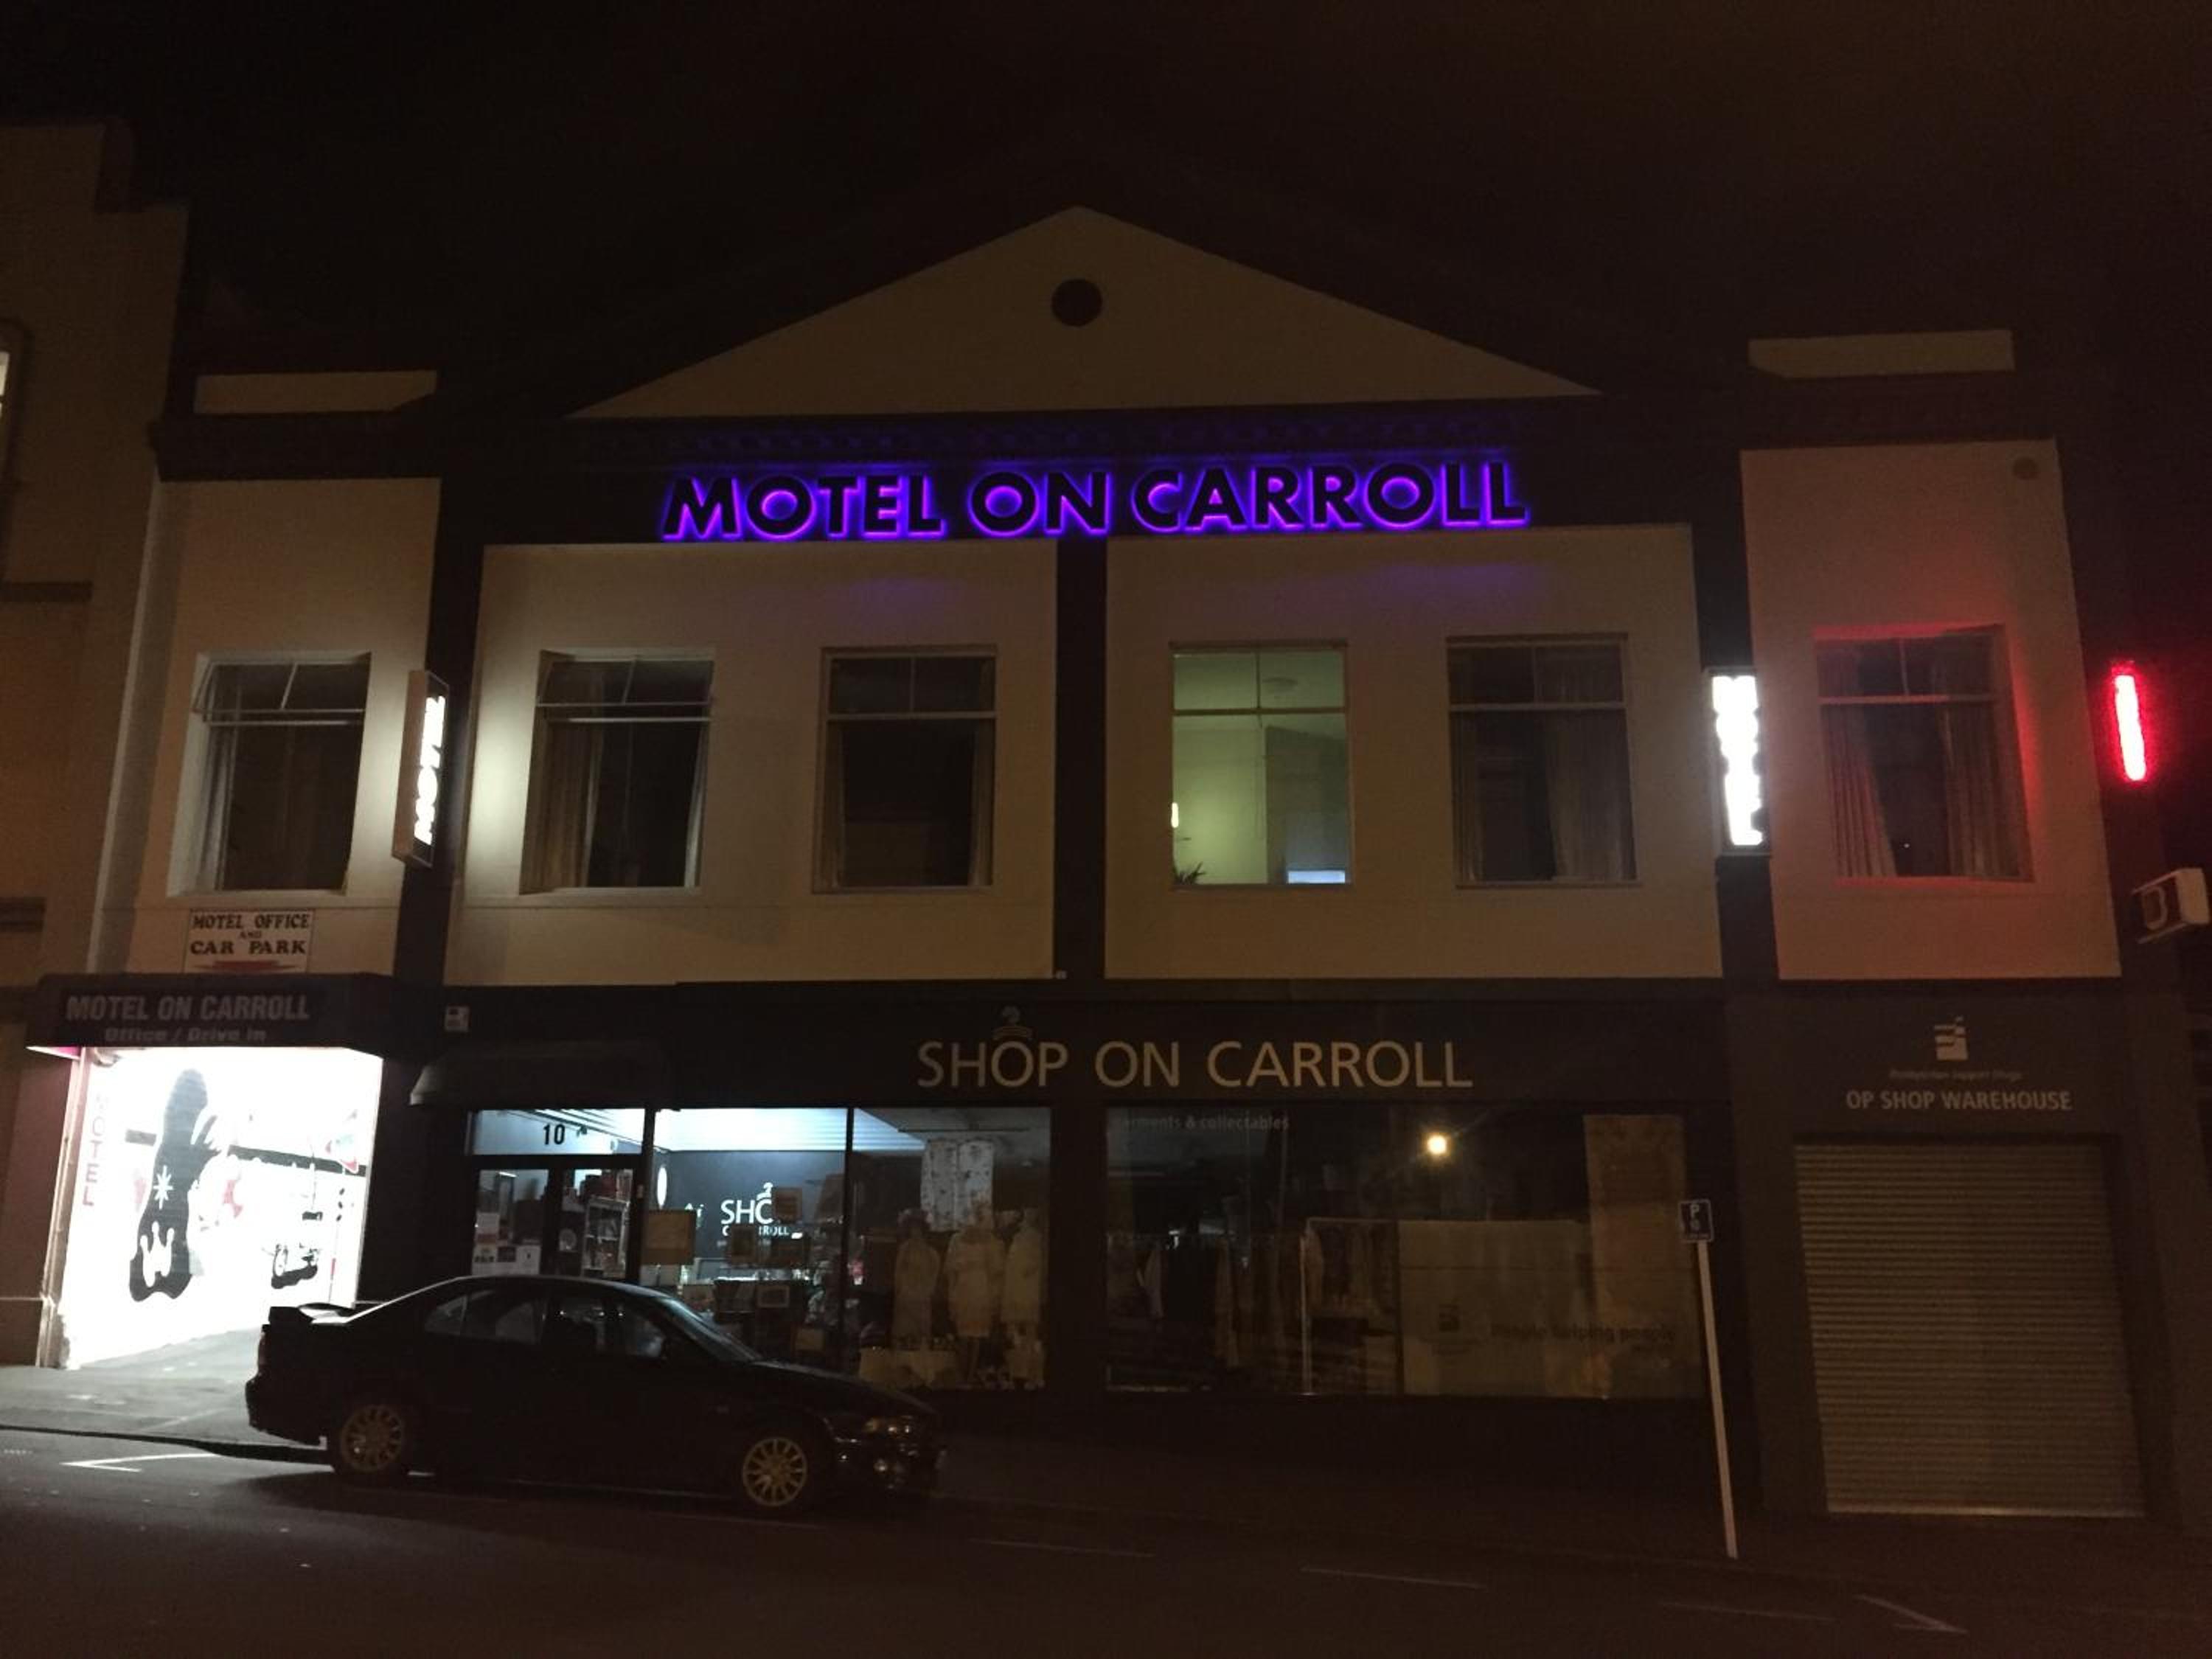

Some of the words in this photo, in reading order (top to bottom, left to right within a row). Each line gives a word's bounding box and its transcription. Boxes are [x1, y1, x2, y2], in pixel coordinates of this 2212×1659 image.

[662, 475, 945, 540] MOTEL
[968, 471, 1108, 537] ON
[1131, 462, 1528, 532] CARROLL
[192, 914, 244, 930] MOTEL
[254, 914, 310, 929] OFFICE
[238, 931, 262, 939] AND
[189, 940, 234, 954] CAR
[248, 940, 307, 954] PARK
[66, 995, 149, 1021] MOTEL
[157, 995, 193, 1021] ON
[200, 994, 310, 1021] CARROLL
[104, 1026, 167, 1042] Office
[187, 1026, 240, 1041] Drive
[917, 1040, 1069, 1088] SHOP
[1094, 1040, 1180, 1088] ON
[1206, 1040, 1474, 1088] CARROLL
[1846, 1090, 1874, 1110] OP
[1880, 1090, 1935, 1110] SHOP
[1941, 1091, 2073, 1110] WAREHOUSE
[543, 1124, 565, 1144] 10
[1690, 1204, 1700, 1219] P
